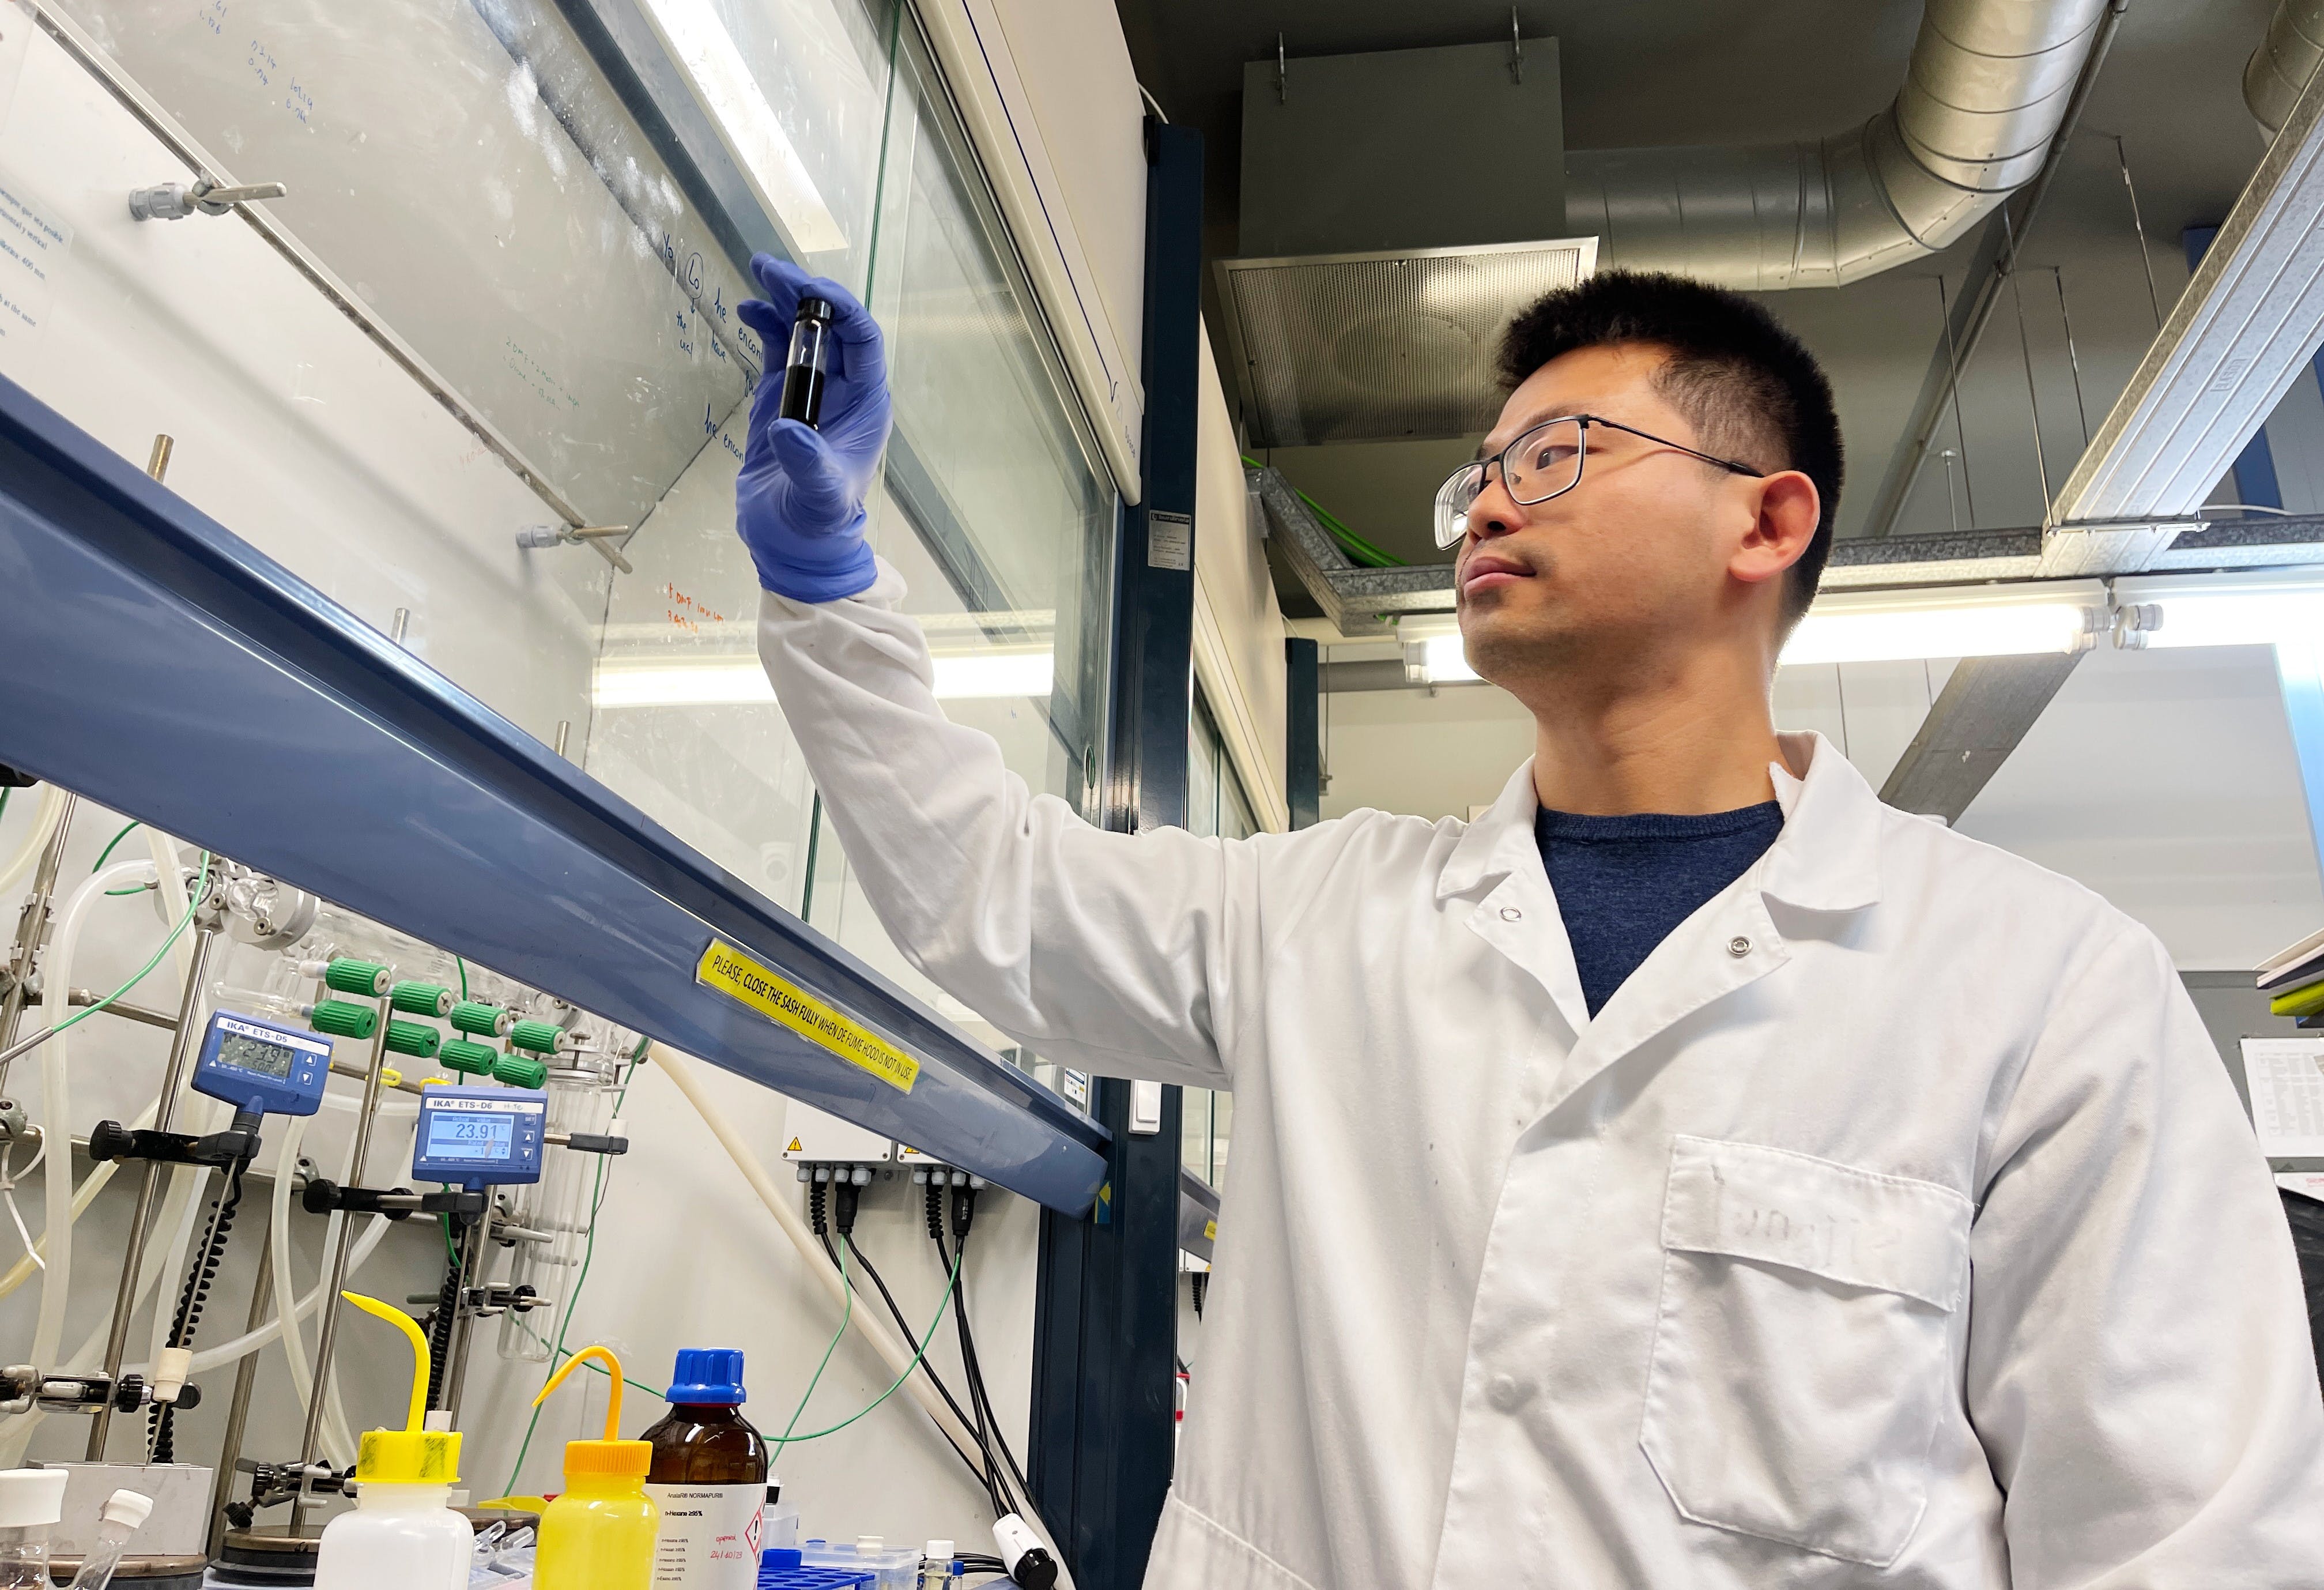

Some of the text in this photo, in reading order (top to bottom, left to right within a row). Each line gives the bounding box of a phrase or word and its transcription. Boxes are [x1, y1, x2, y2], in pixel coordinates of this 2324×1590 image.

[11, 304, 21, 315] the
[21, 313, 36, 327] same
[714, 287, 726, 323] he
[705, 403, 717, 439] he
[712, 954, 912, 1081] PLEASE, CLOSE THE SASH FULLY WHEN DE FUME HOOD IS NOT IN USE
[458, 1101, 492, 1109] ETS-D6
[455, 1124, 496, 1139] 23.91
